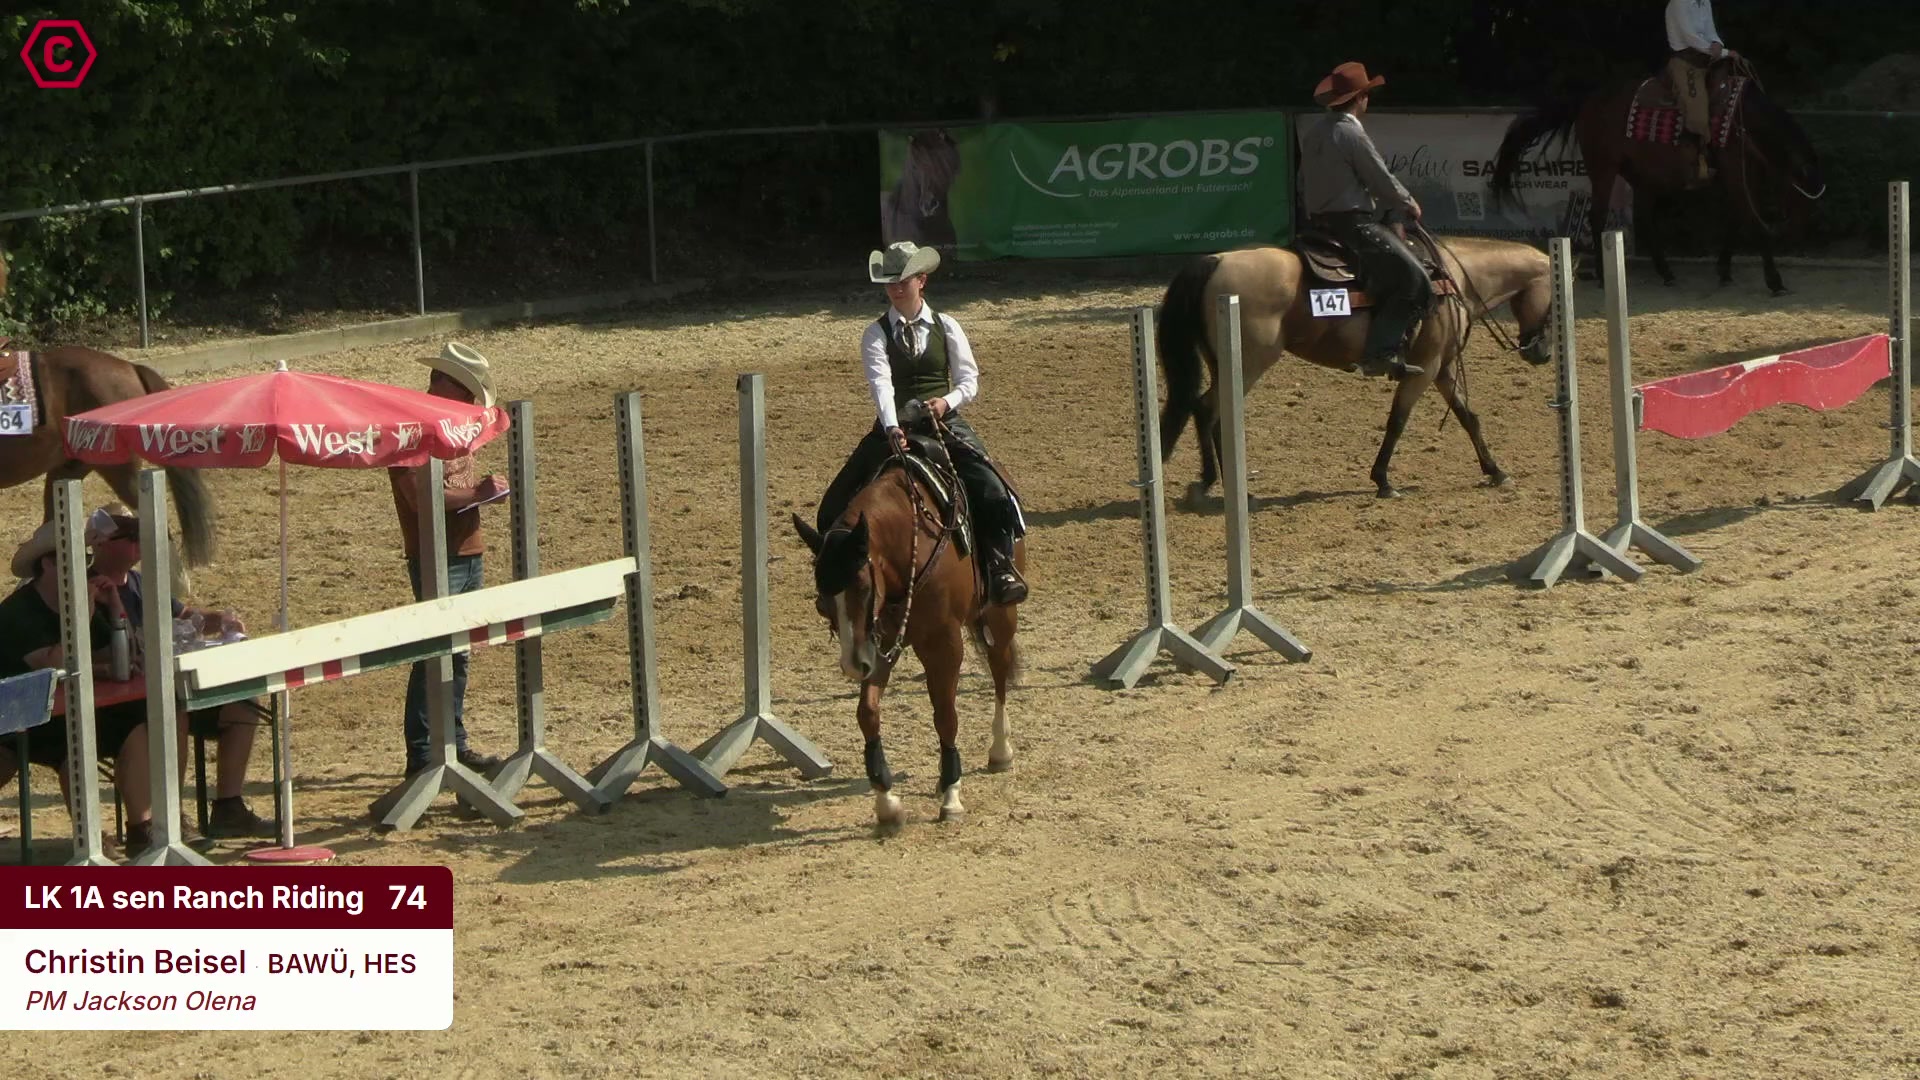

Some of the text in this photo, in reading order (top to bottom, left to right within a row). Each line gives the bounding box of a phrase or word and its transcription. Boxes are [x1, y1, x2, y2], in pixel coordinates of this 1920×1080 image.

[1462, 160, 1588, 177] SAPHIRE
[1088, 188, 1109, 199] Das
[1181, 183, 1194, 193] im
[1534, 180, 1568, 189] WEAR
[1173, 227, 1256, 241] www.agrobs.de
[1315, 294, 1345, 312] 147
[0, 411, 23, 430] 64
[139, 422, 224, 458] West
[290, 422, 378, 458] West
